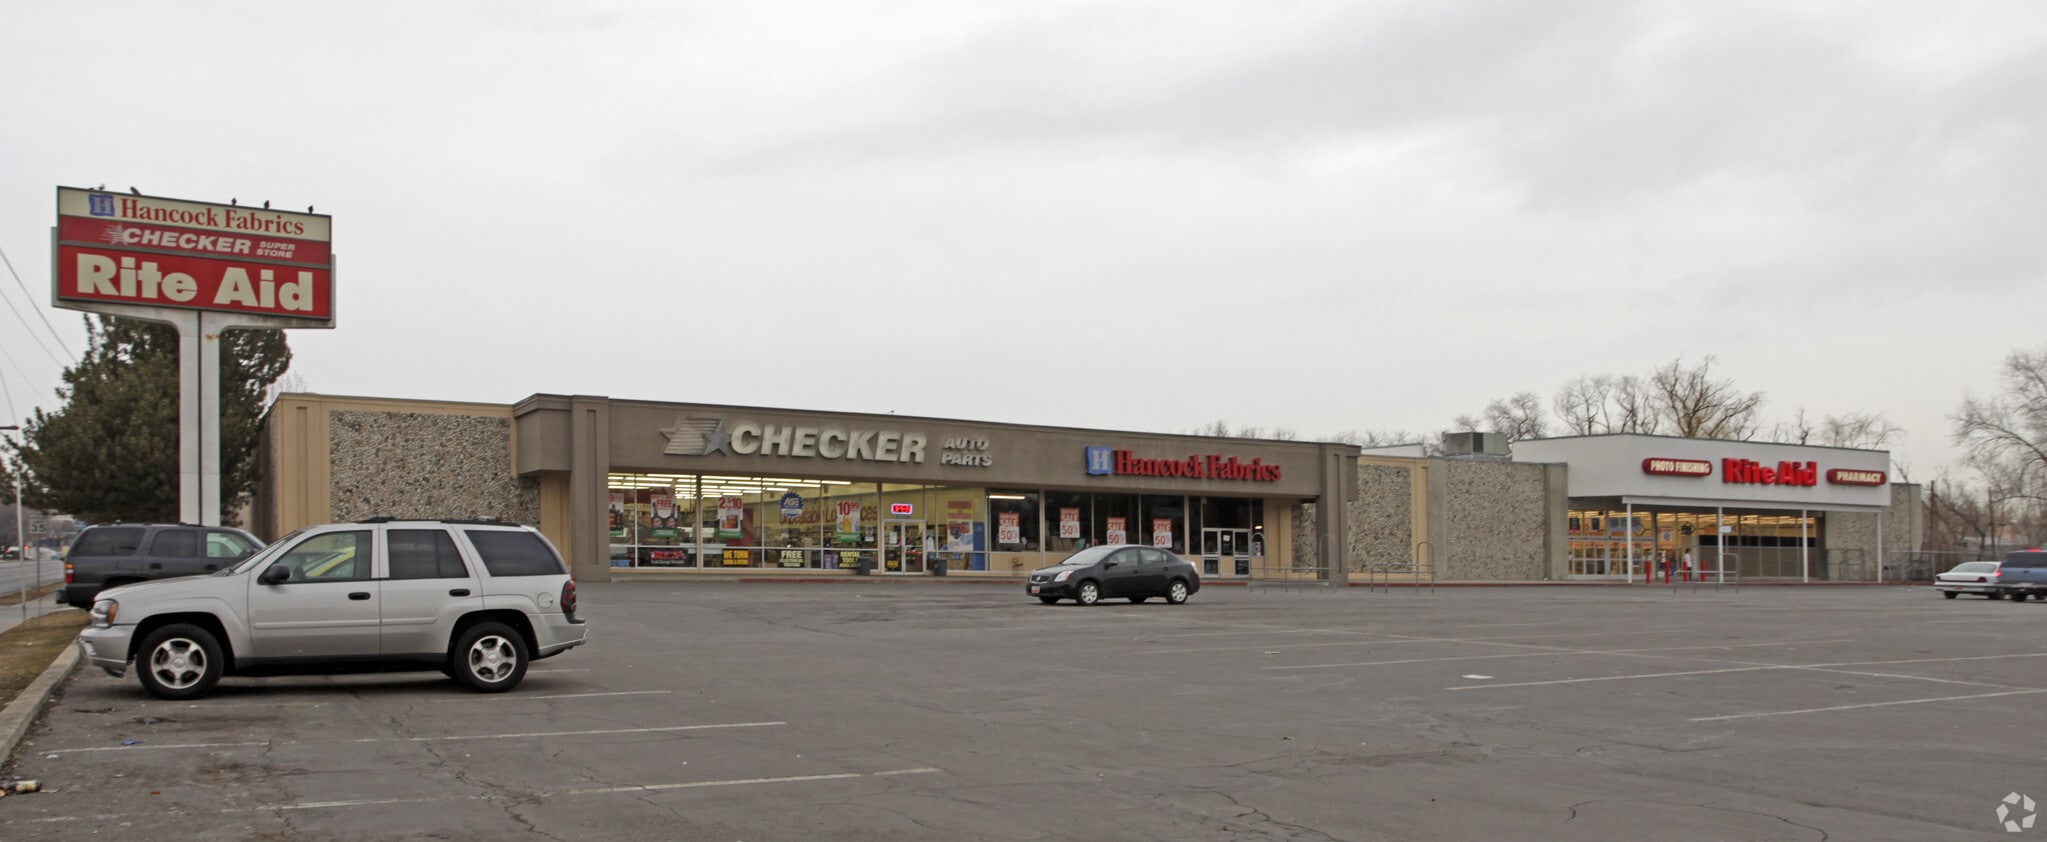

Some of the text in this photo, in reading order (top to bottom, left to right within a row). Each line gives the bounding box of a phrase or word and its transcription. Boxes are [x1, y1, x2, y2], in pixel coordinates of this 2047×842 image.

[92, 194, 304, 235] H Hancock Fabrics
[122, 228, 252, 254] CHECKER
[260, 241, 296, 251] SUPER
[256, 248, 293, 258] STORE
[76, 253, 313, 311] Rite Aid
[730, 423, 927, 463] CHECKER
[943, 438, 990, 450] AUTO
[941, 452, 993, 467] PARTS
[1092, 449, 1282, 481] H Hancock Fabrics
[1650, 460, 1711, 474] PHOTO FINISHING
[1721, 458, 1818, 486] Rite Aid
[1836, 471, 1882, 483] PHARMACY
[31, 524, 46, 533] 35
[781, 550, 803, 559] FREE
